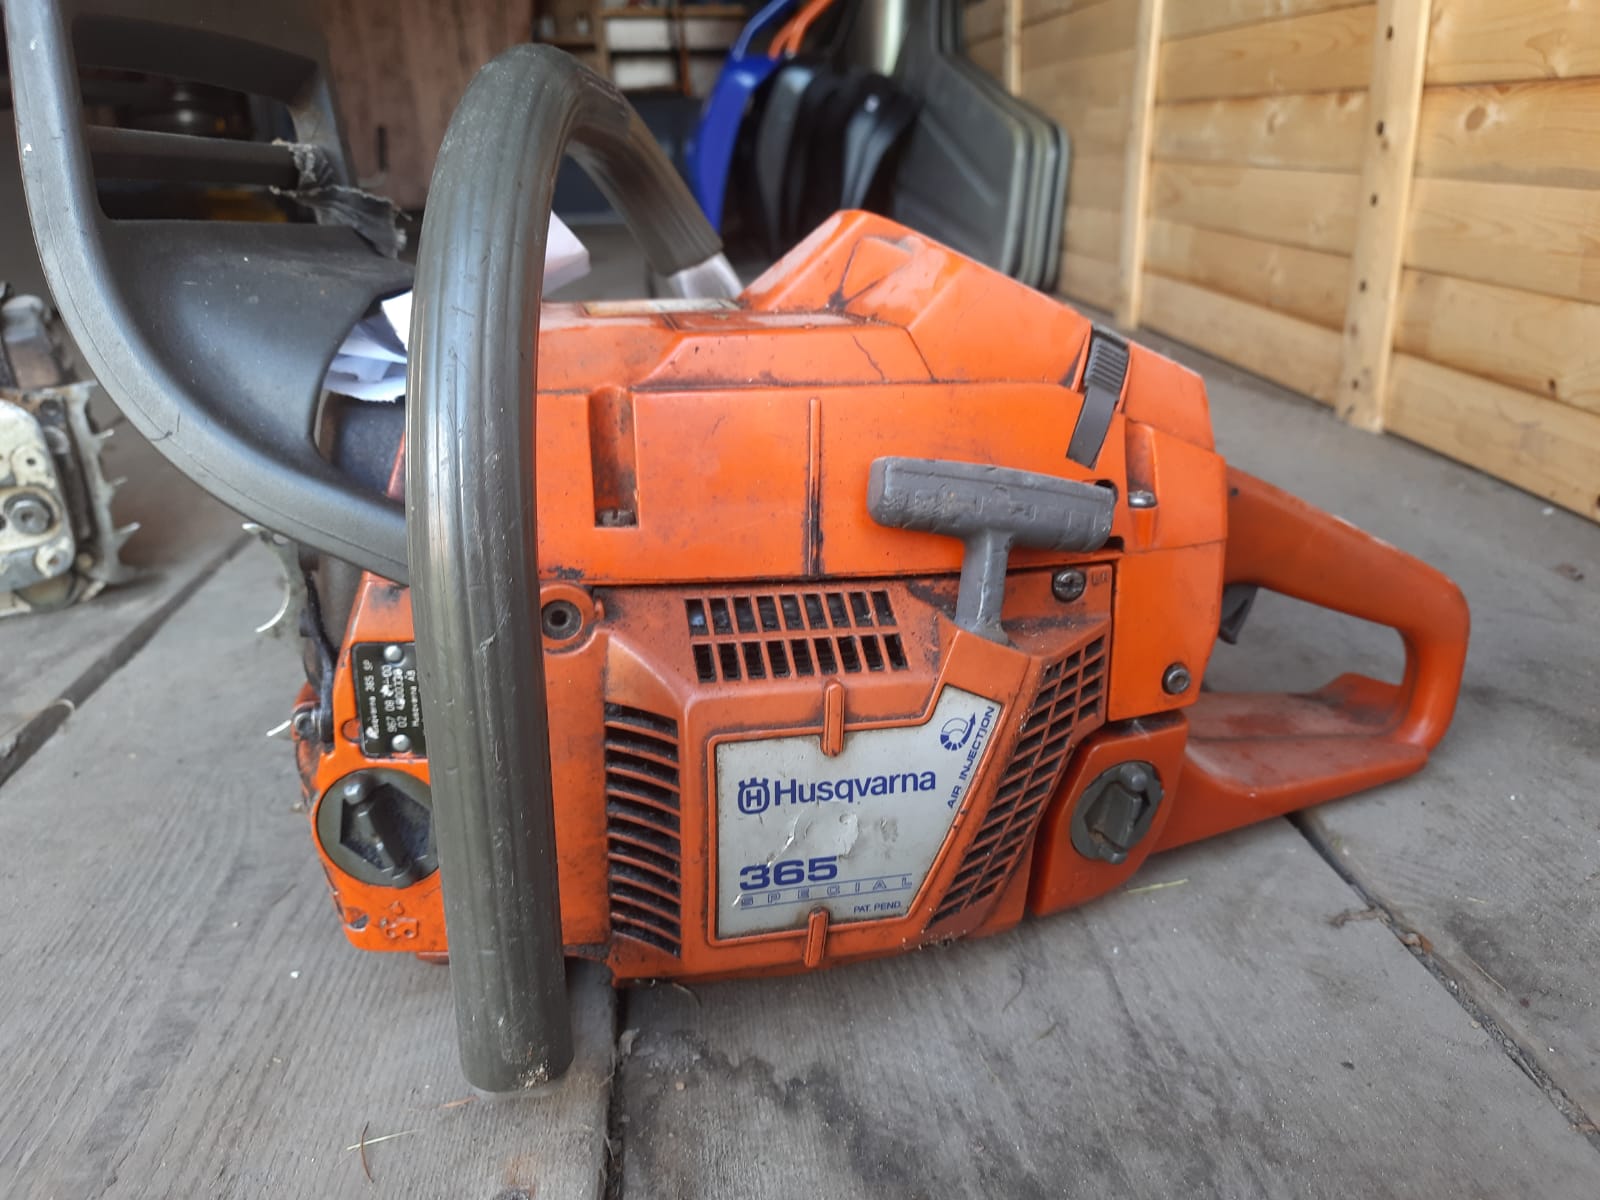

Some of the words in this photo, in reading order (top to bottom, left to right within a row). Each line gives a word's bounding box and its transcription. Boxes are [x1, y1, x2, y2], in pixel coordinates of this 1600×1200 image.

[362, 659, 373, 671] SP
[364, 675, 375, 692] 365
[397, 716, 407, 729] 02
[410, 686, 419, 727] Husqvarna
[947, 785, 962, 809] AIR
[959, 706, 995, 780] INJECTION
[774, 771, 936, 806] Husqvarna
[739, 856, 838, 891] 365
[740, 877, 912, 906] SPECIAL
